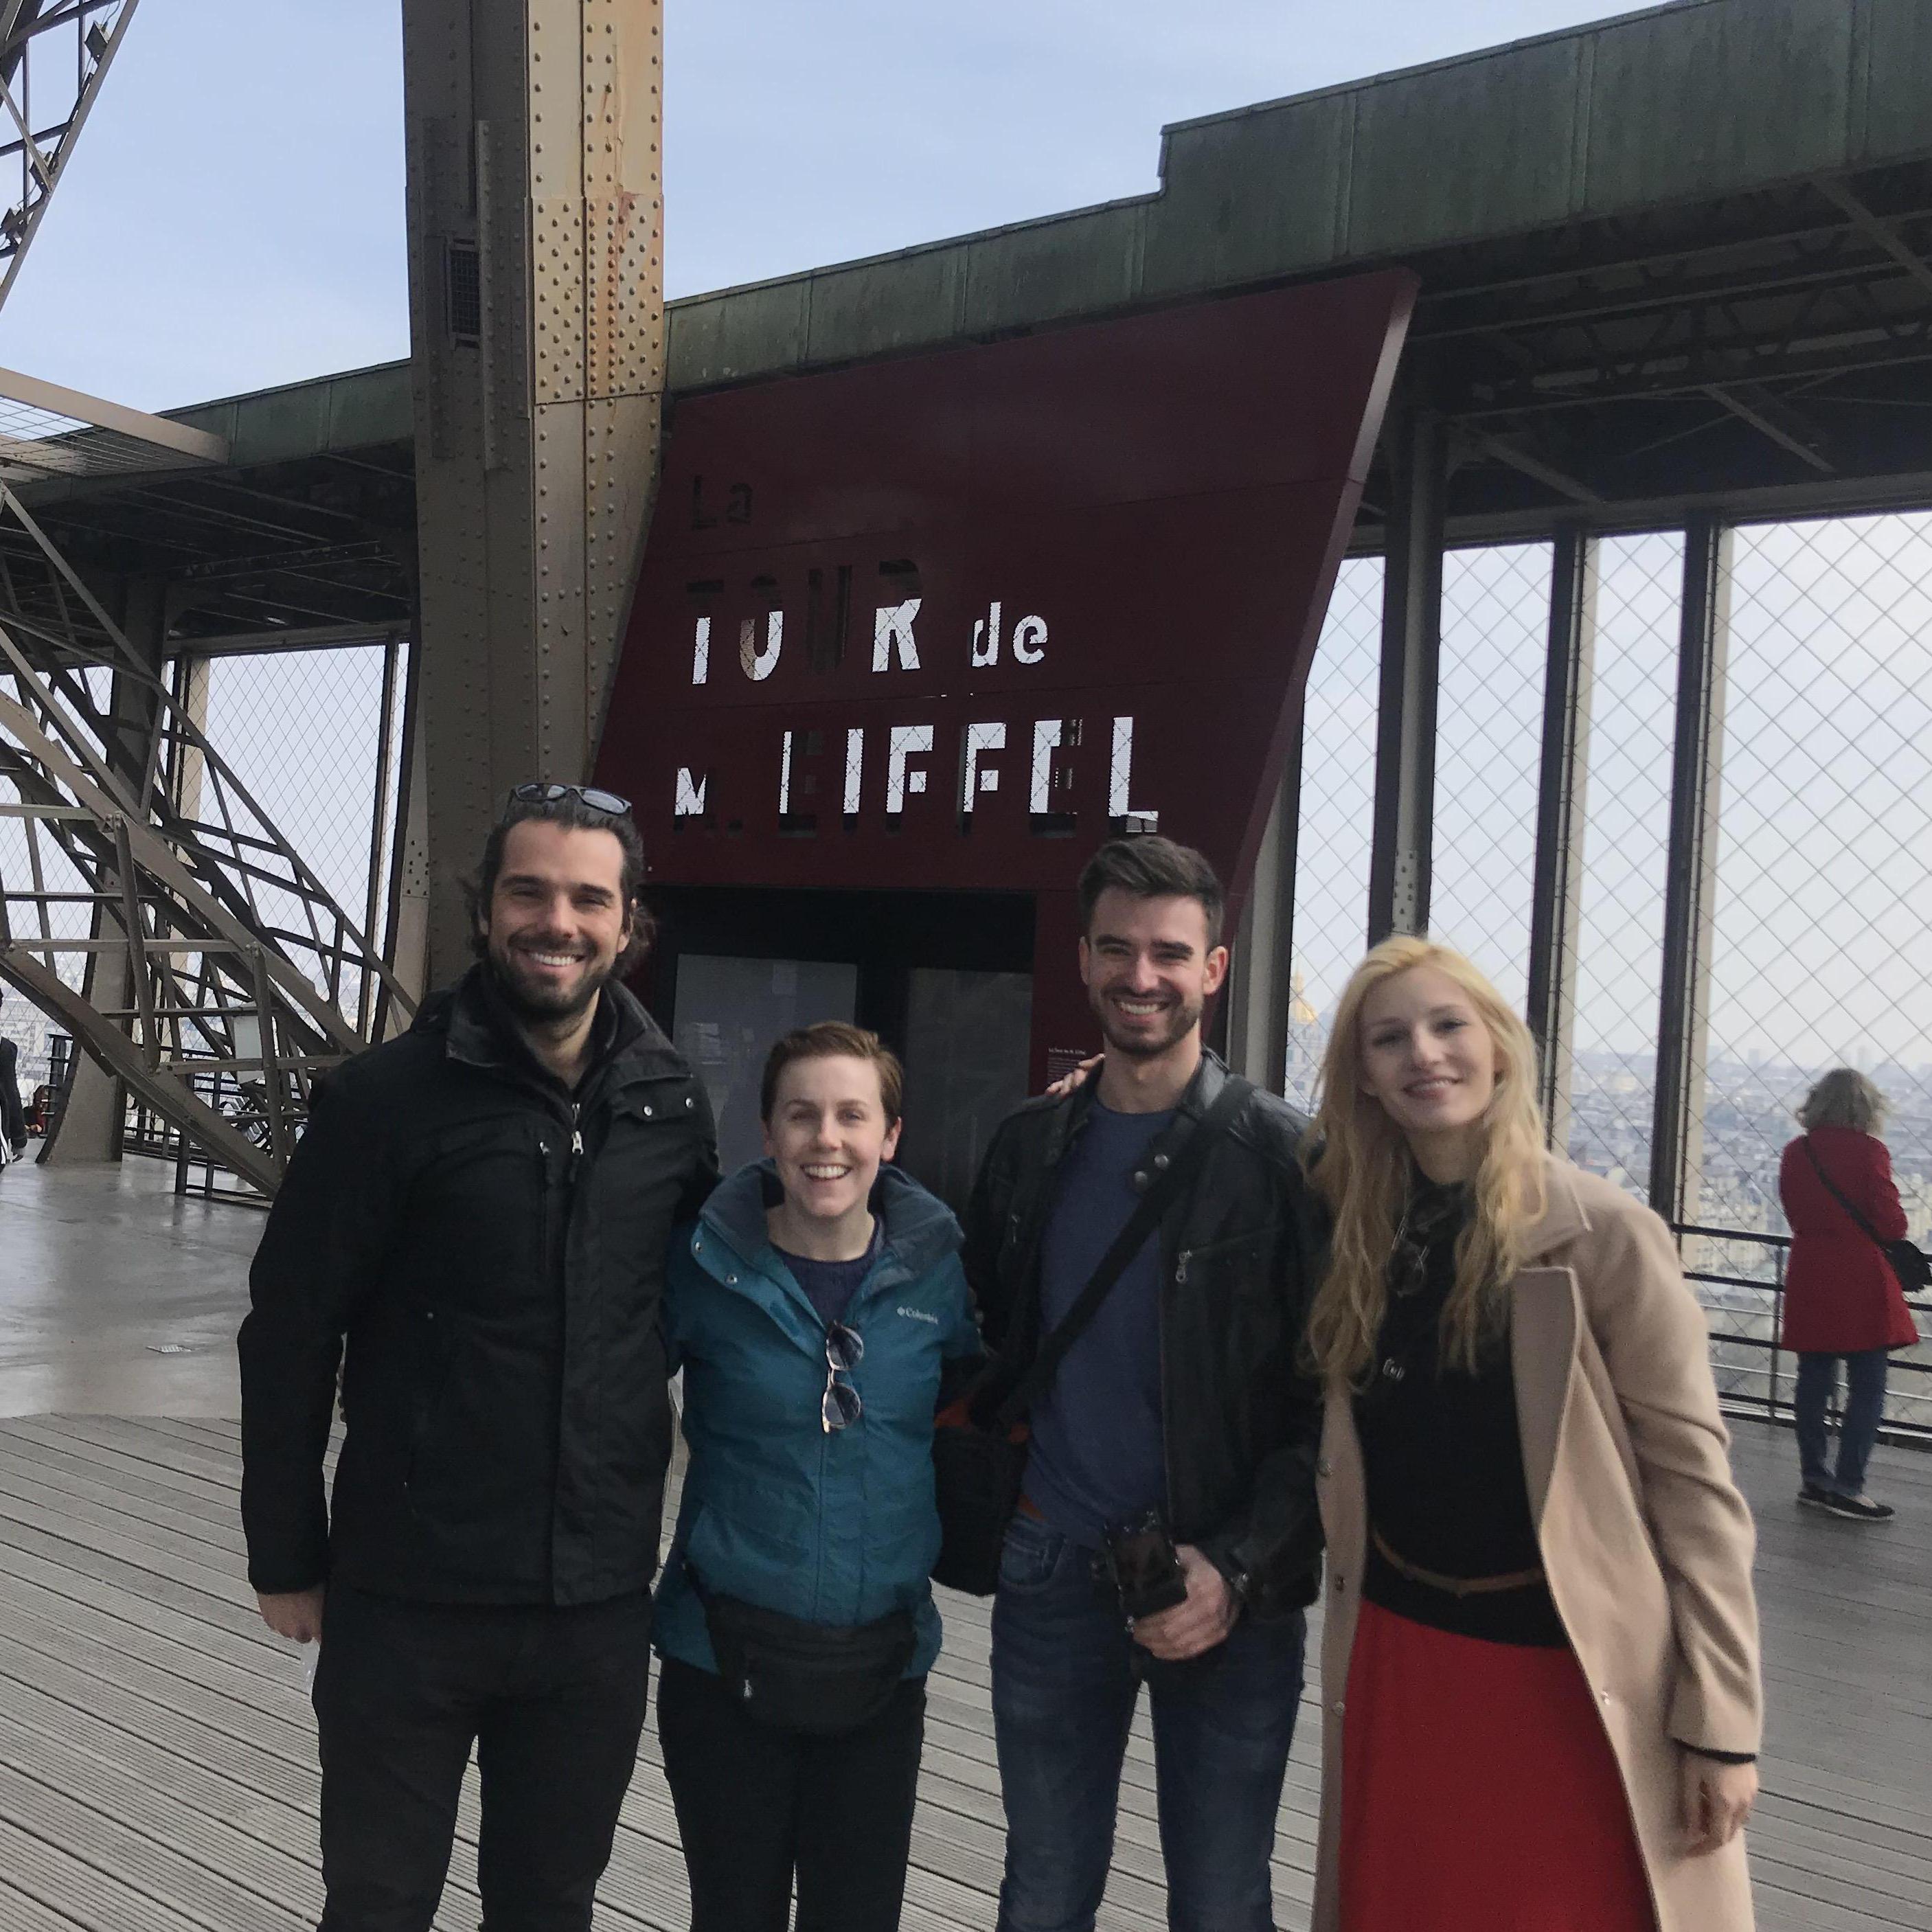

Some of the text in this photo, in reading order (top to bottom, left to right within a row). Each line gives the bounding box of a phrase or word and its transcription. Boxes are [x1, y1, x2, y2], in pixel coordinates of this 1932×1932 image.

[691, 475, 753, 530] La
[685, 558, 1049, 685] TOUR de
[777, 716, 1159, 839] EIFFEL
